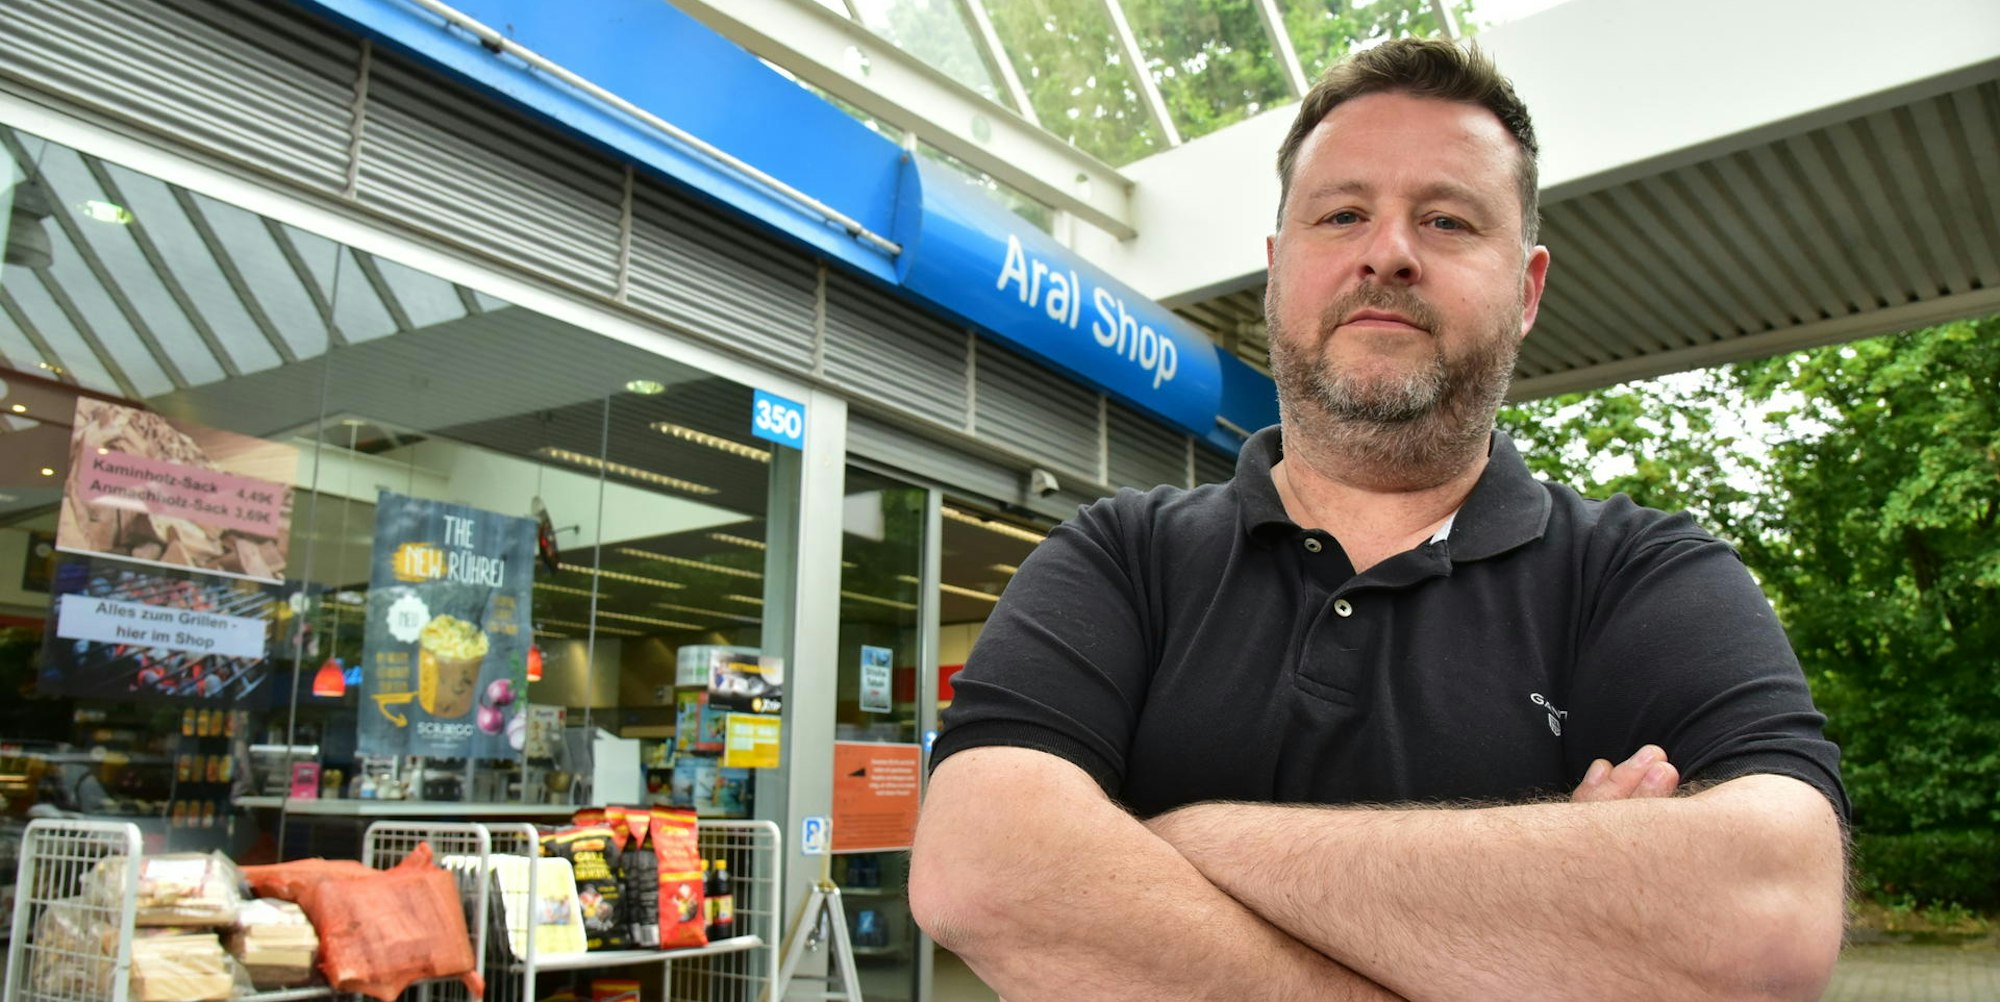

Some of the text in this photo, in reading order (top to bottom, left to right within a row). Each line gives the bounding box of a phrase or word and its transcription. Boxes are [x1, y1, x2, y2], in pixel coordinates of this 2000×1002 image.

[997, 233, 1178, 390] Aral Shop
[755, 399, 802, 439] 350
[93, 458, 218, 493] Kaminholz-Sack
[443, 515, 475, 549] THE
[405, 545, 505, 588] NEW RÜHREI
[96, 602, 136, 618] Alles
[141, 610, 173, 623] zum
[179, 612, 228, 629] Grillen
[116, 625, 215, 649] hier im Shop
